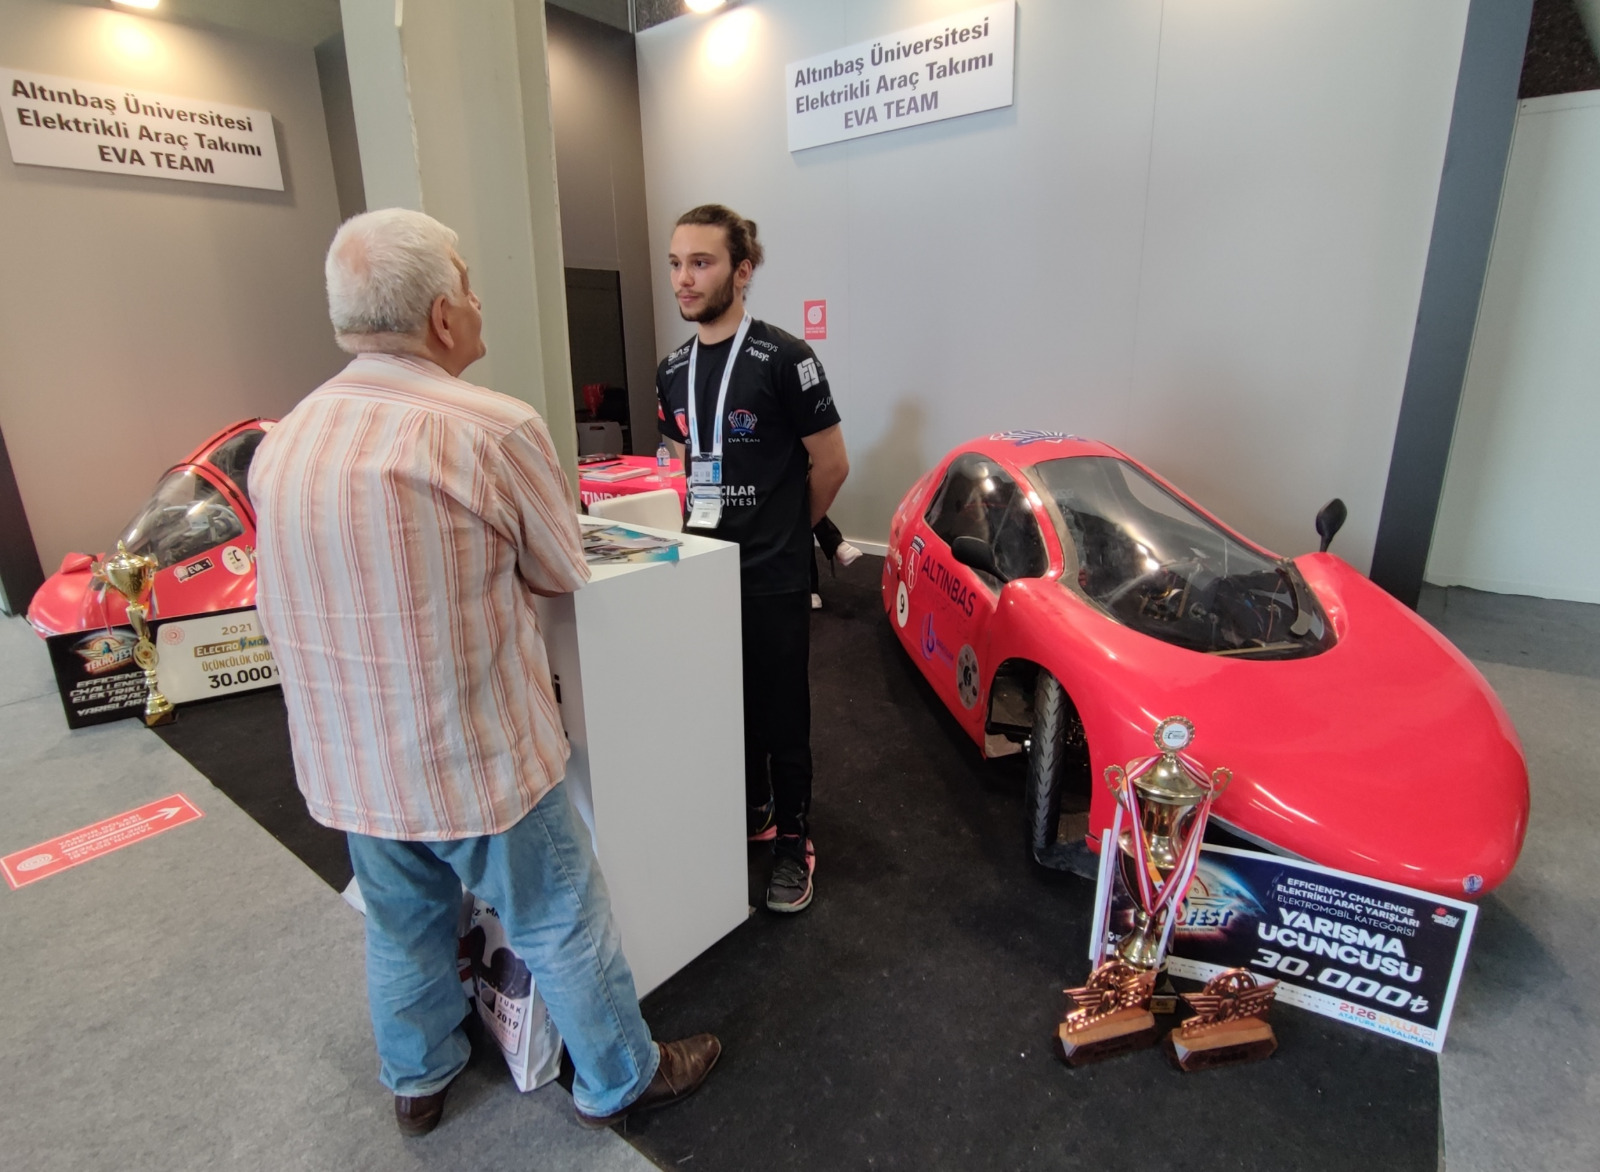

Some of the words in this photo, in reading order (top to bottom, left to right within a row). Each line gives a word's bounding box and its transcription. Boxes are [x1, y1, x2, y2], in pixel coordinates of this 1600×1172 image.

[794, 57, 865, 88] Altınbaş
[870, 17, 990, 67] Üniversitesi
[796, 79, 870, 114] Elektrikli
[875, 71, 920, 95] Araç
[926, 53, 994, 81] Takımı
[12, 79, 117, 115] Altınbaş
[124, 93, 254, 132] Üniversitesi
[844, 106, 878, 129] EVA
[884, 91, 939, 120] TEAM
[17, 108, 129, 139] Elektrikli
[138, 124, 189, 150] Araç
[194, 132, 262, 157] Takımı
[98, 145, 145, 166] EVA
[150, 151, 215, 174] TEAM
[900, 594, 905, 613] 9
[221, 623, 252, 636] 2021
[253, 650, 274, 663] ÖDÜL
[76, 671, 144, 688] EFFICIENC
[1287, 878, 1347, 898] EFFICIENCY
[1349, 893, 1415, 917] CHALLENGE
[1334, 899, 1363, 914] ARAÇ
[1365, 907, 1420, 928] YARIŞLARI
[1277, 894, 1352, 920] ELEKTROMOBİL
[1354, 914, 1415, 937] KATEGORİSİ
[497, 1010, 519, 1030] 2019
